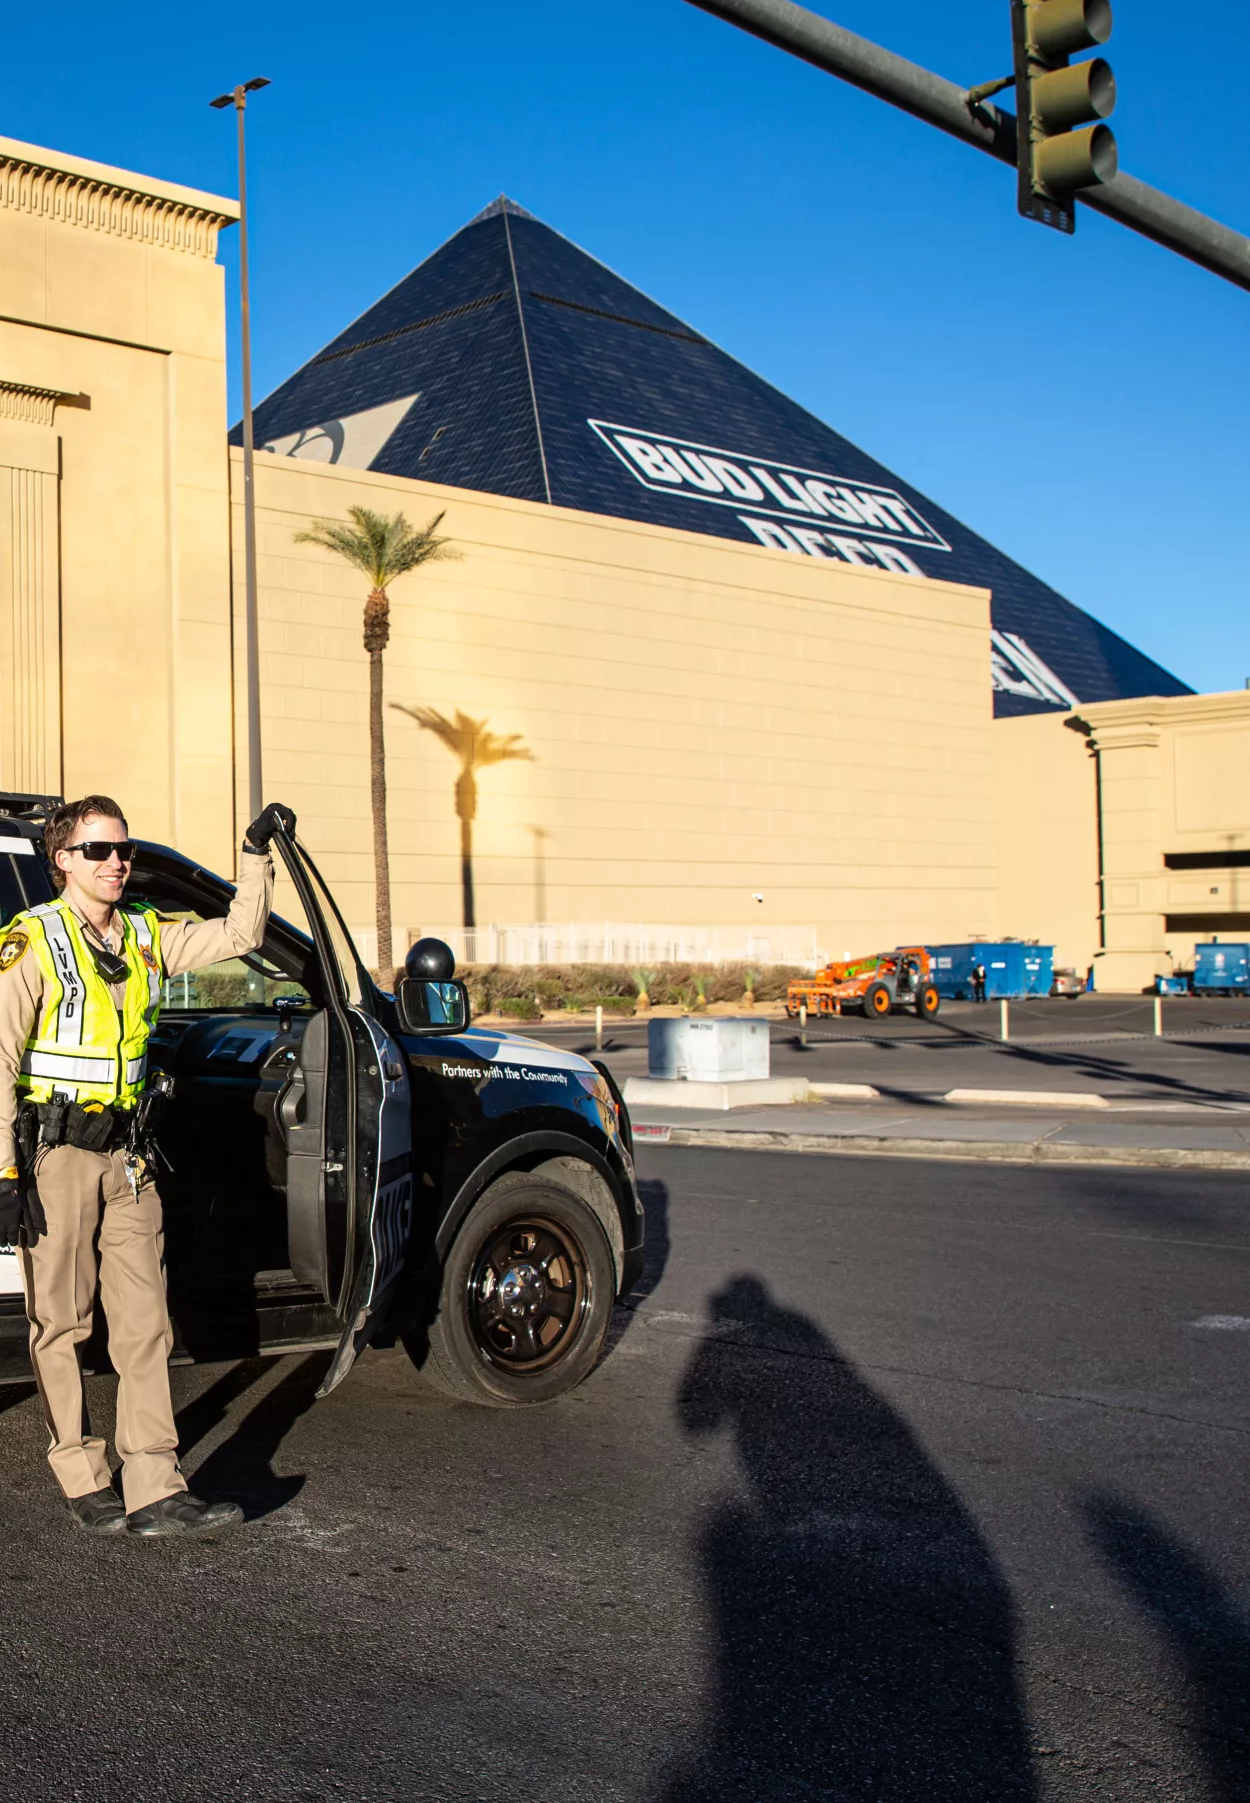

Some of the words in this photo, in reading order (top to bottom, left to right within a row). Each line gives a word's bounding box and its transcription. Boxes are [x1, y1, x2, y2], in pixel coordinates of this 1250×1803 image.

[614, 434, 764, 501] BUD
[749, 466, 926, 536] LIGHT
[53, 938, 78, 1018] LVMPD
[441, 1063, 482, 1079] Partners
[482, 1065, 503, 1079] with
[504, 1066, 521, 1080] the
[521, 1068, 568, 1086] Community
